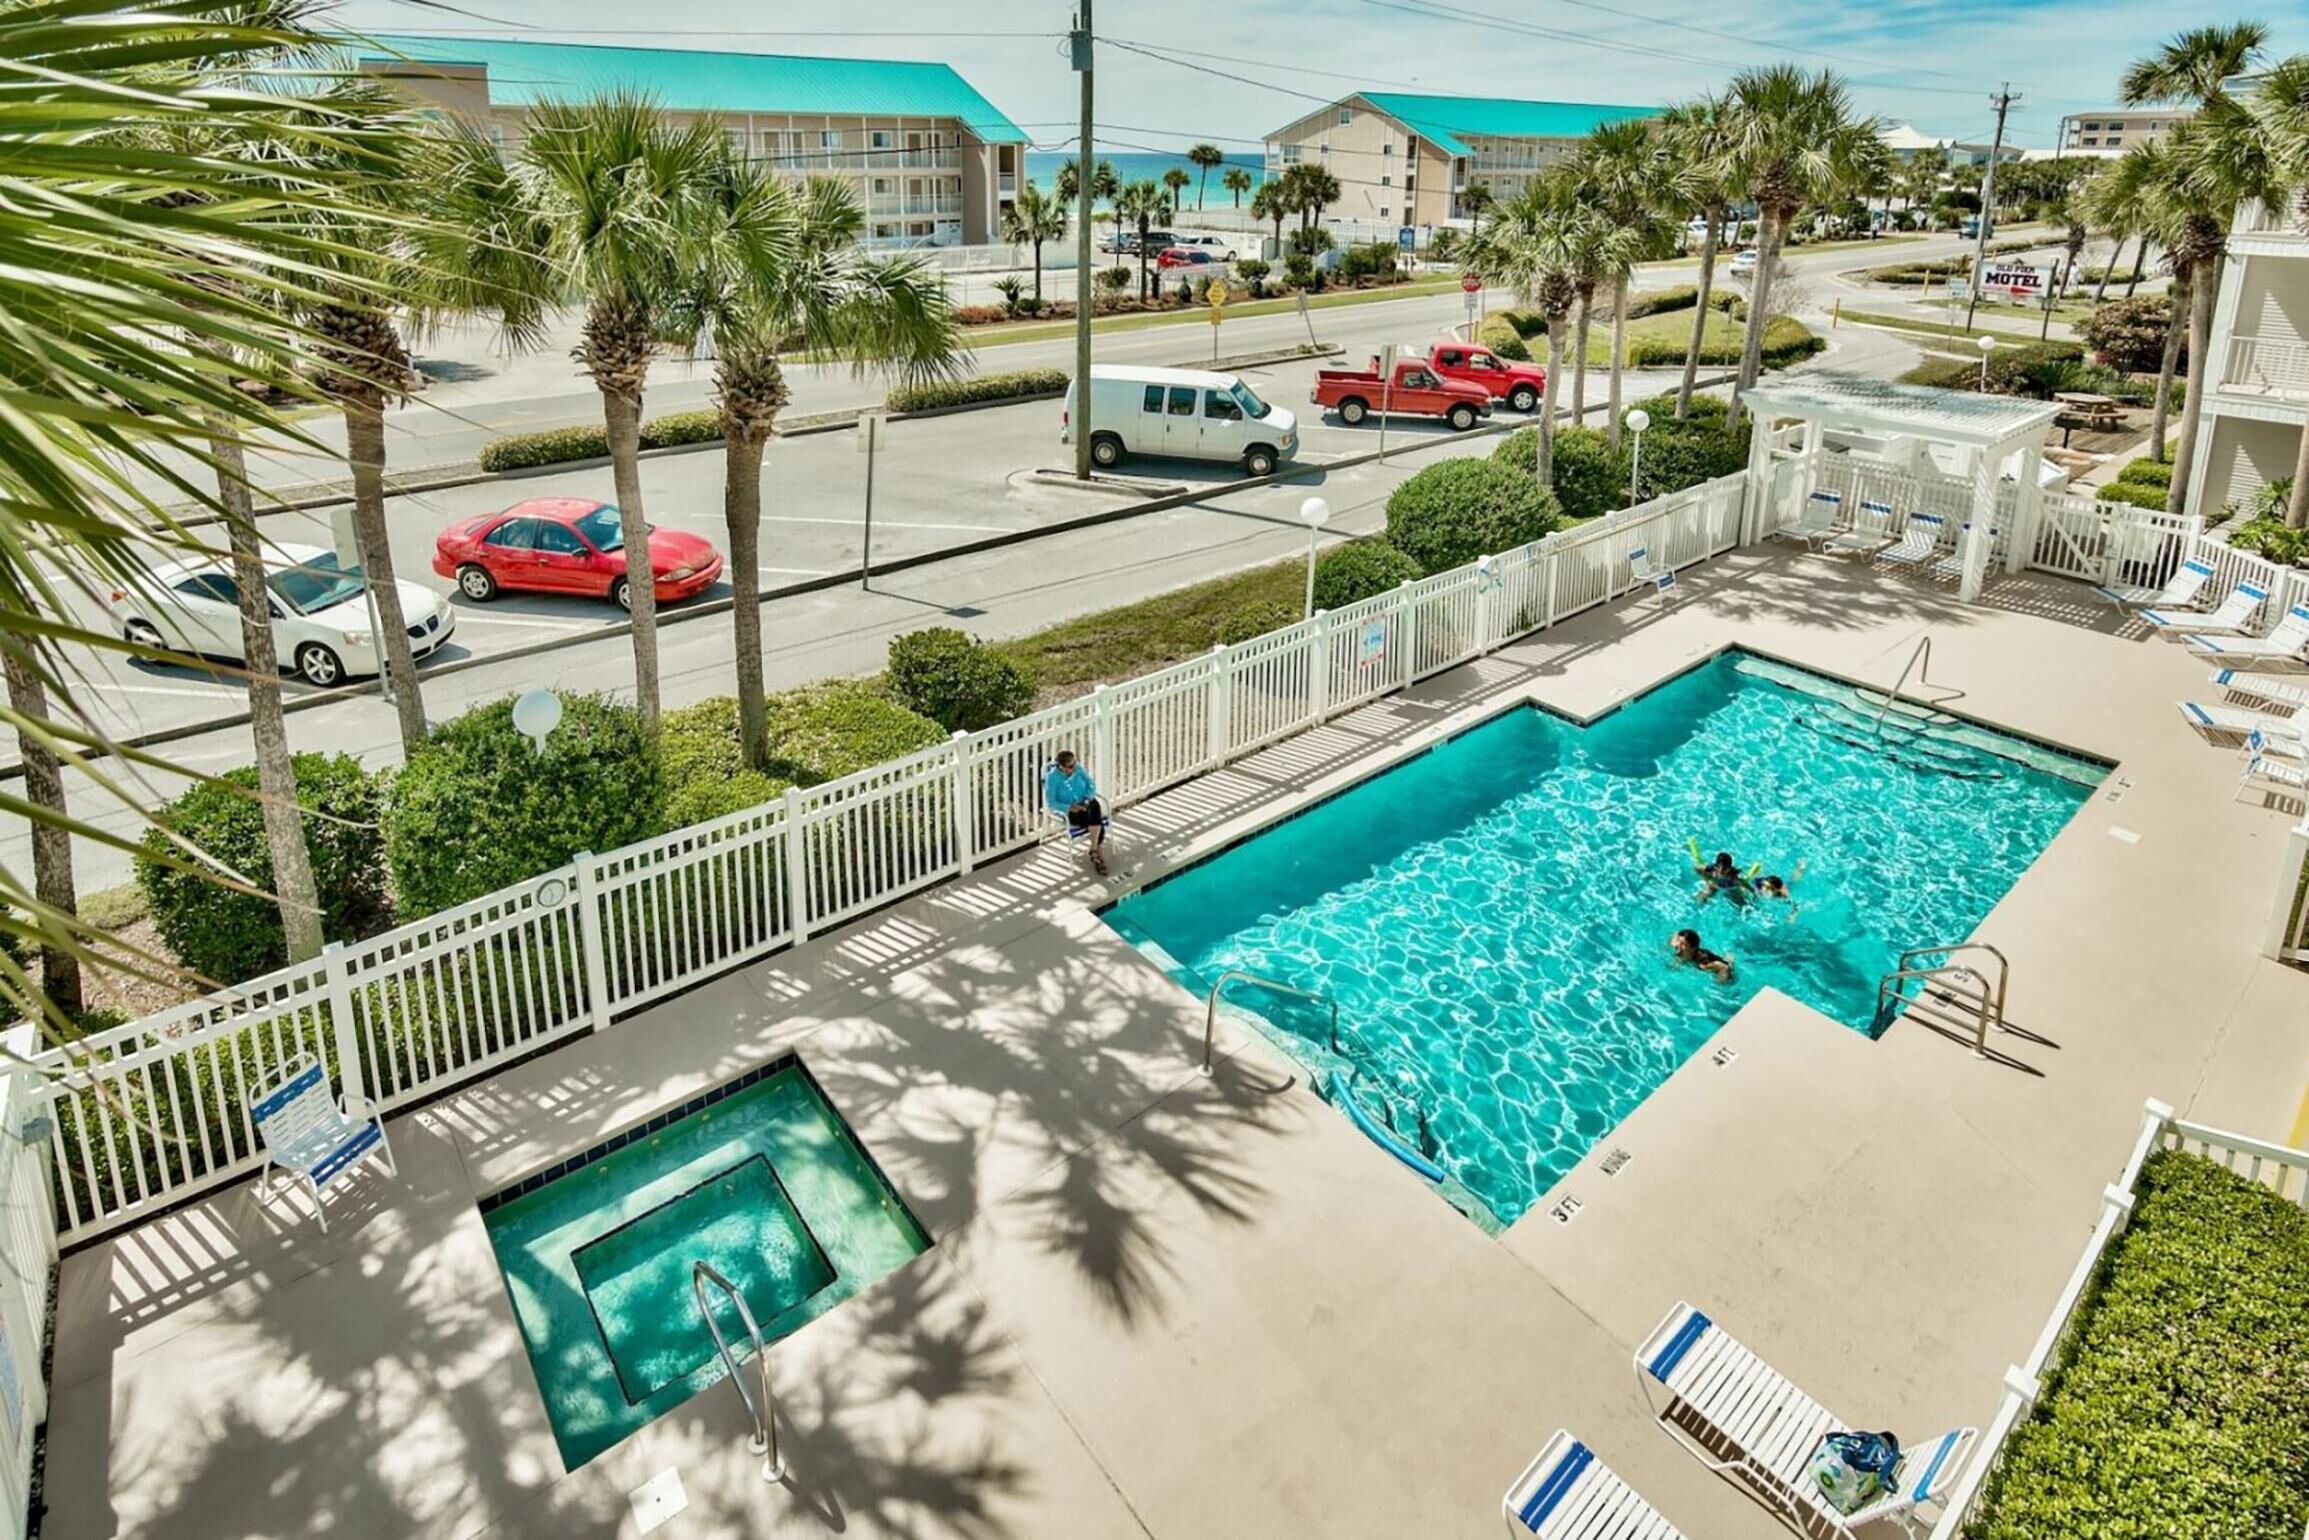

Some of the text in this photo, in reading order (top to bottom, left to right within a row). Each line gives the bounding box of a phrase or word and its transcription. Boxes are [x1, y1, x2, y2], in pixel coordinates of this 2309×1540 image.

[1985, 272, 2042, 287] MOTEL
[1551, 1195, 1583, 1222] 3 FT
